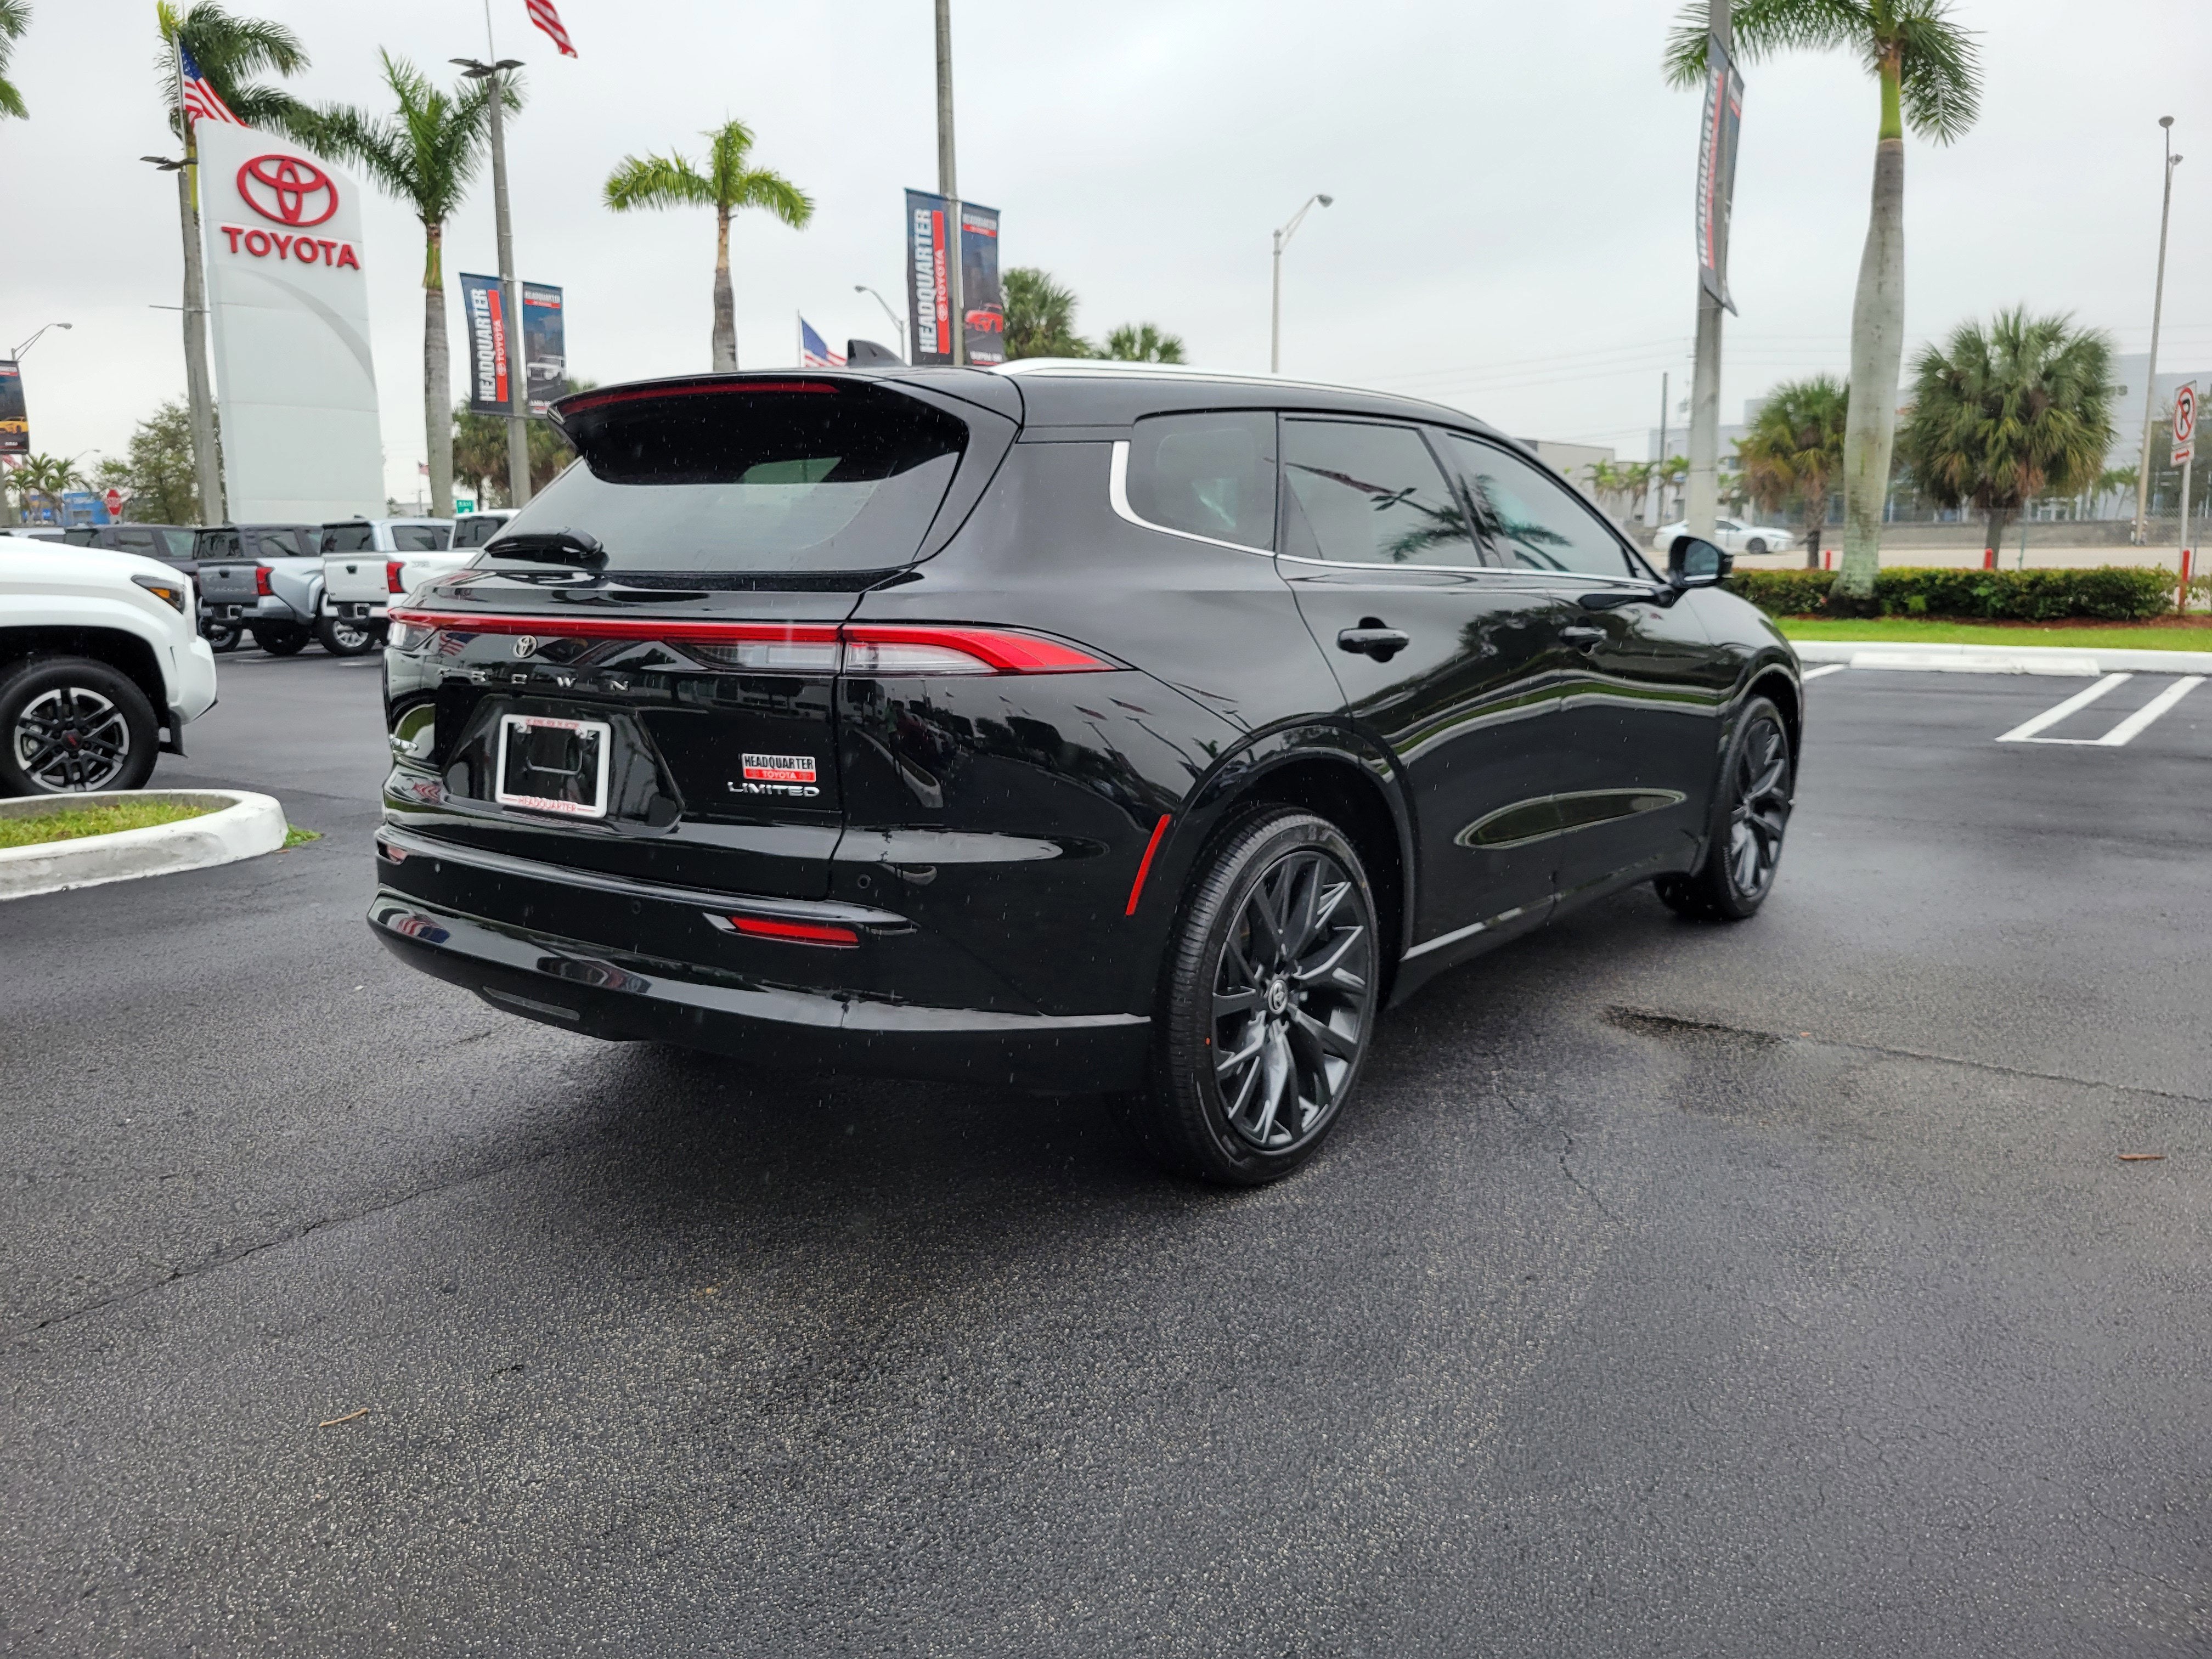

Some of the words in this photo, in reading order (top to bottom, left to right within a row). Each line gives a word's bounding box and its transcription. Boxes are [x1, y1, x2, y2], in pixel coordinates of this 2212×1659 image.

[221, 226, 361, 270] TOYOTA
[913, 208, 938, 354] HEADQUARTER
[934, 249, 947, 301] TOYOTA
[471, 289, 496, 402] HEADQUARTER
[493, 319, 505, 361] TOYOTA
[744, 755, 814, 769] HEADQUARTER
[763, 770, 797, 779] TOYOTA
[517, 796, 577, 812] HEADQUARTER
[727, 781, 820, 797] LIMITED
